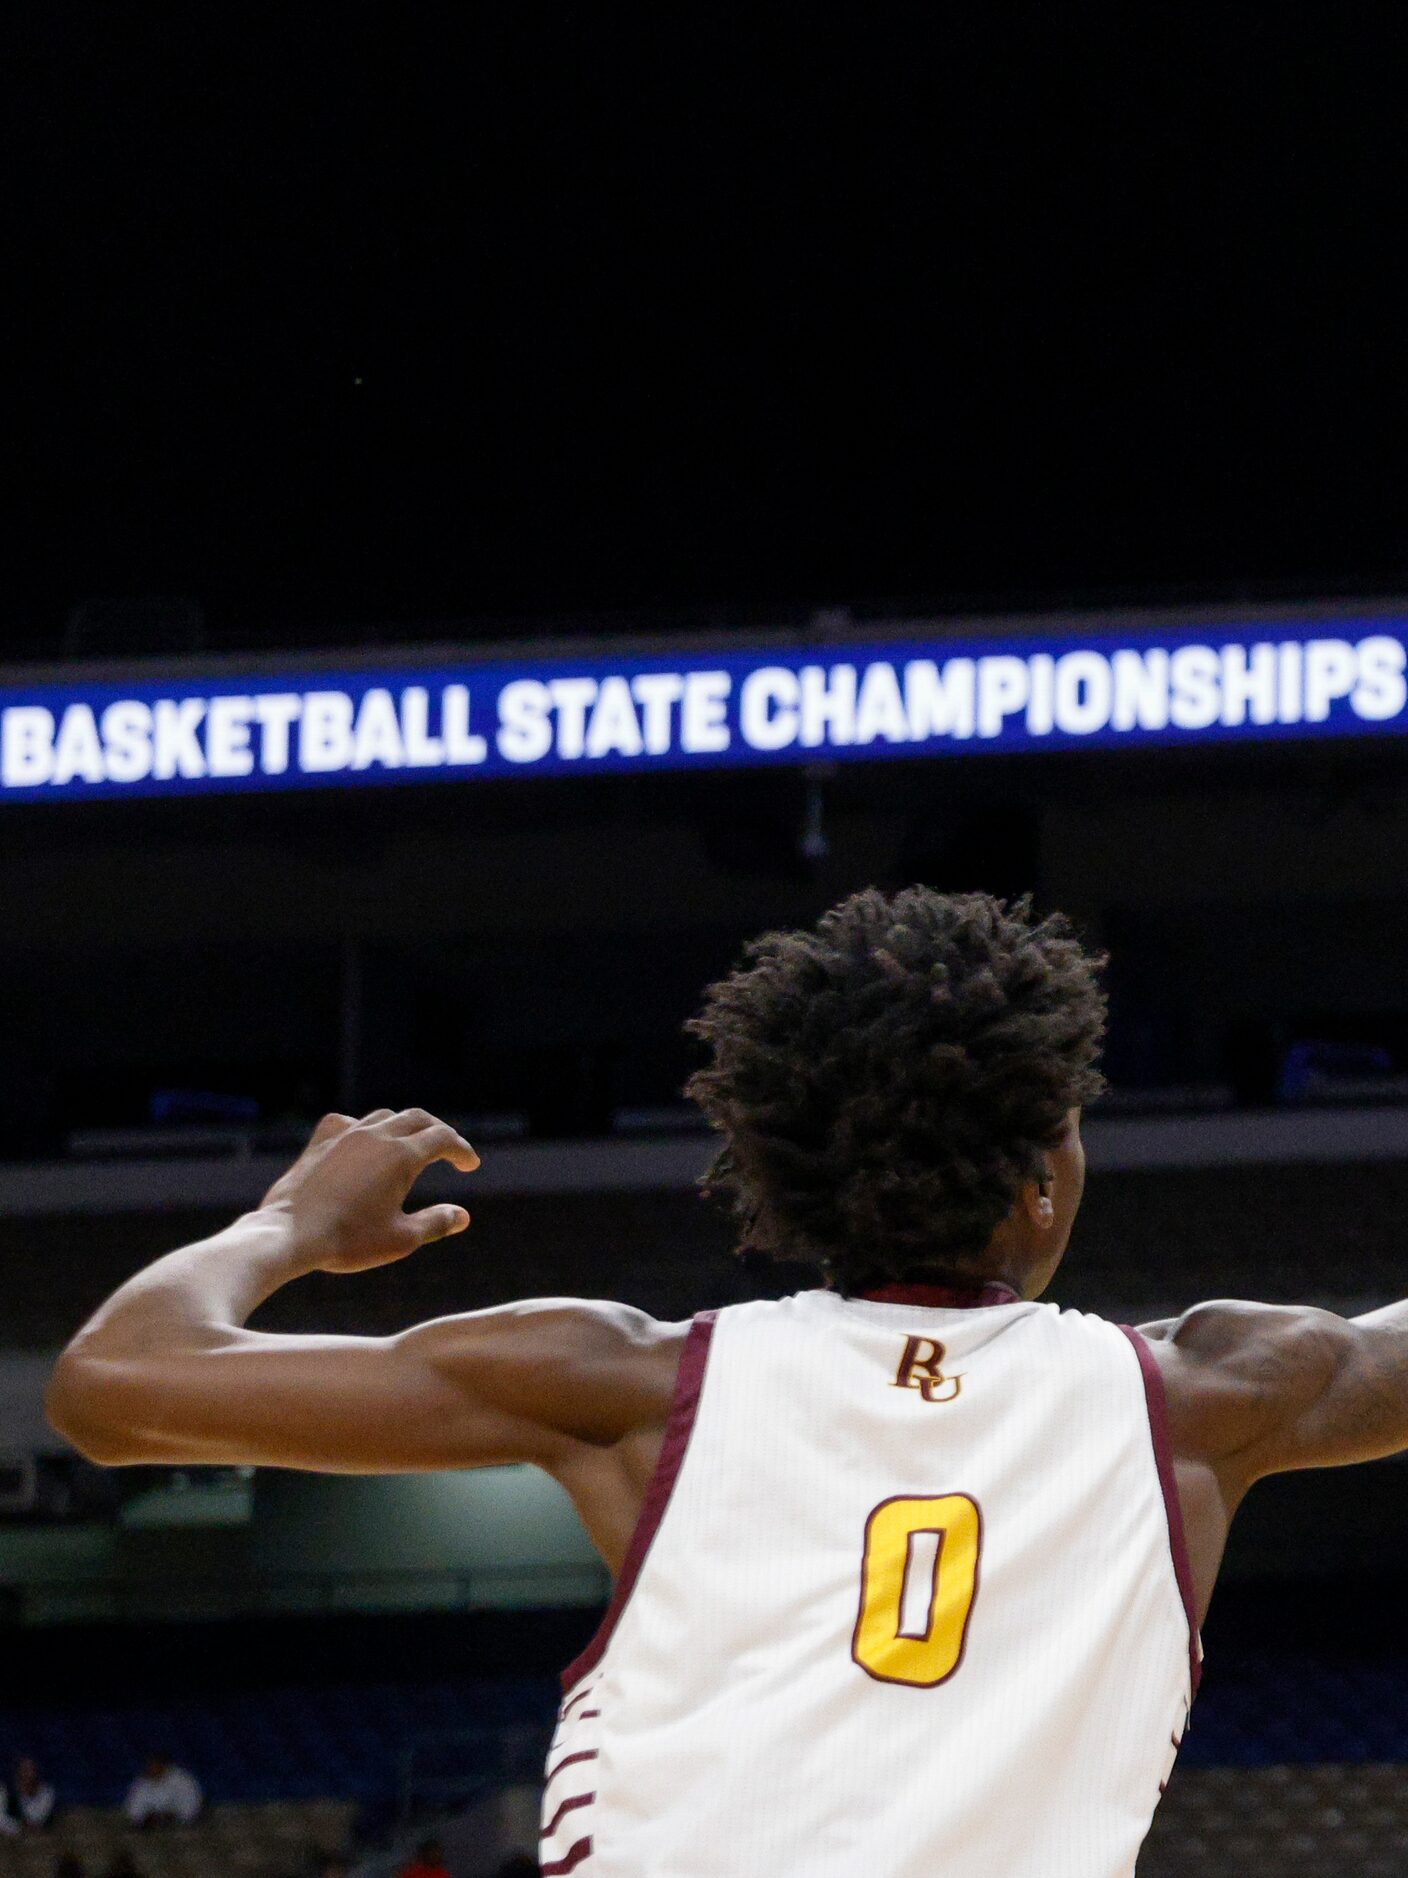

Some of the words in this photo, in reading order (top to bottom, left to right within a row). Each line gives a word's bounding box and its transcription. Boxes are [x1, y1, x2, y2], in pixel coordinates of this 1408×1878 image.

[0, 684, 487, 788] BASKETBALL
[497, 670, 730, 763] STATE
[740, 636, 1406, 750] CHAMPIONSHIPS
[851, 1491, 985, 1690] 0
